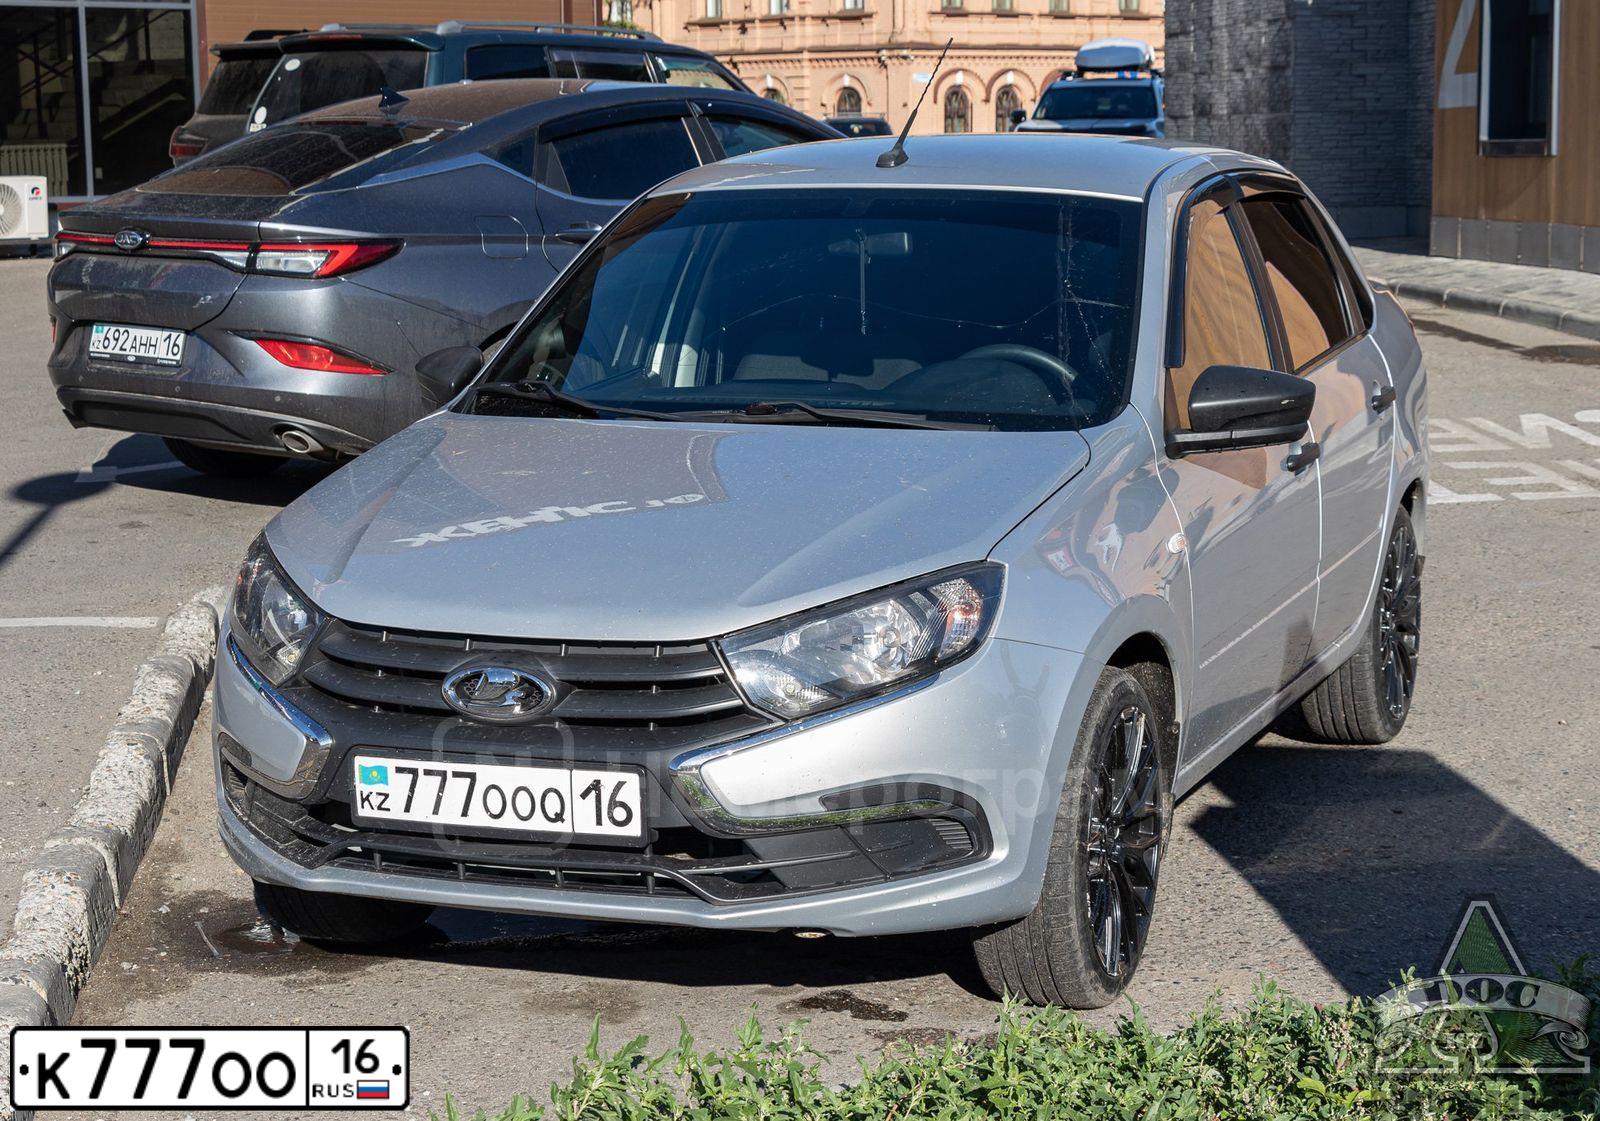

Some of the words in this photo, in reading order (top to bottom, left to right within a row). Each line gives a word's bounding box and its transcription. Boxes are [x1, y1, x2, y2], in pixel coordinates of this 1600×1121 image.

[102, 327, 159, 355] 692AHH
[163, 333, 181, 357] 16
[360, 790, 391, 812] KZ
[395, 766, 566, 824] 777OOQ
[579, 779, 634, 828] 16
